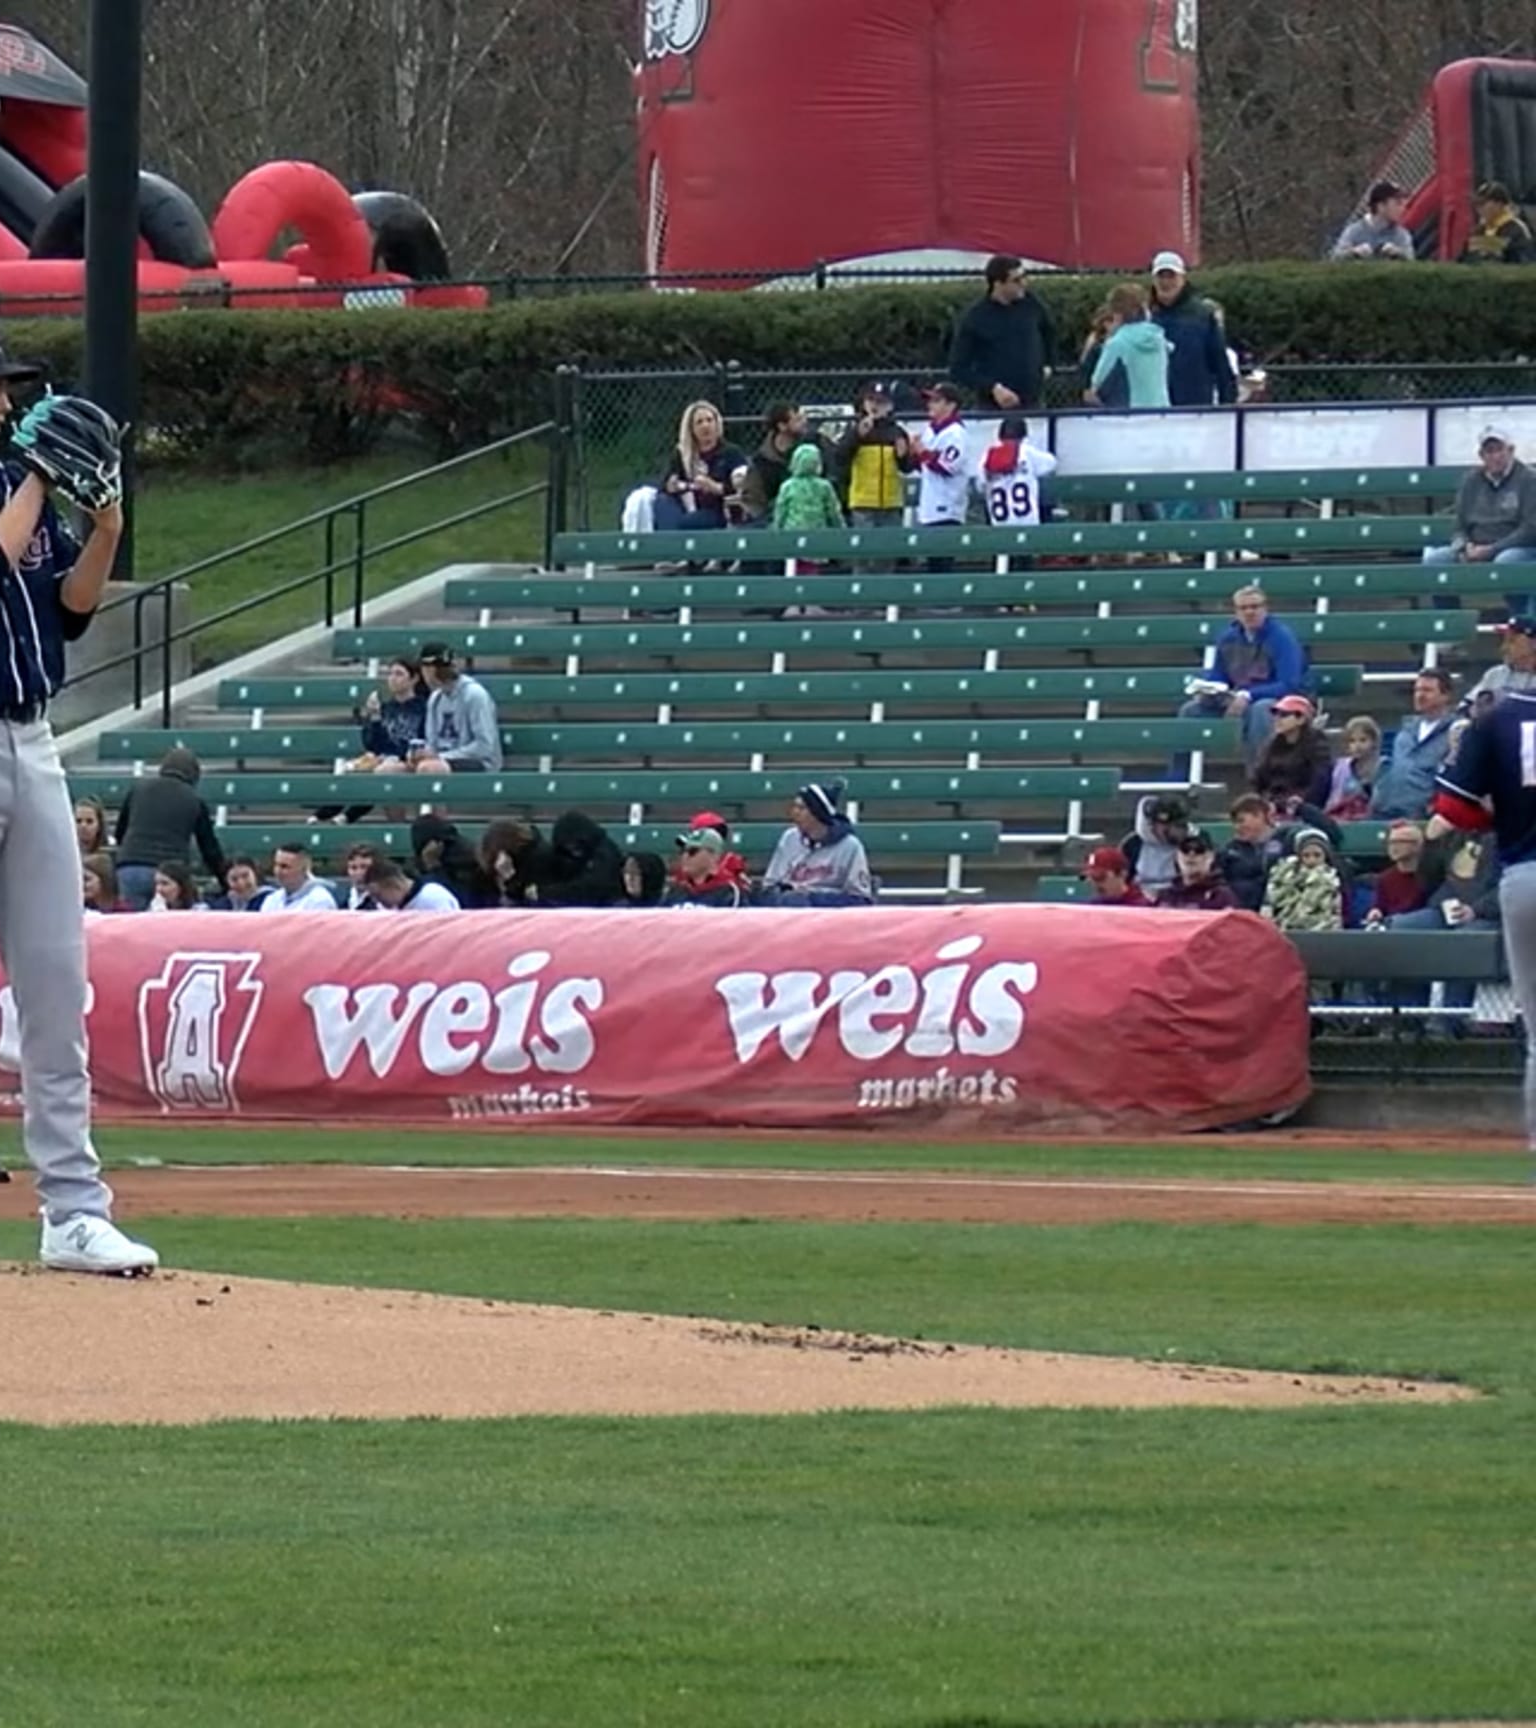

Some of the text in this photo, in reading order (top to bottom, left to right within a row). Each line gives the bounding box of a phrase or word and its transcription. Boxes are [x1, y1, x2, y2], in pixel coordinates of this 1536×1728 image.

[303, 951, 604, 1079] weis
[715, 935, 1039, 1064] weis
[857, 1066, 1018, 1107] markets
